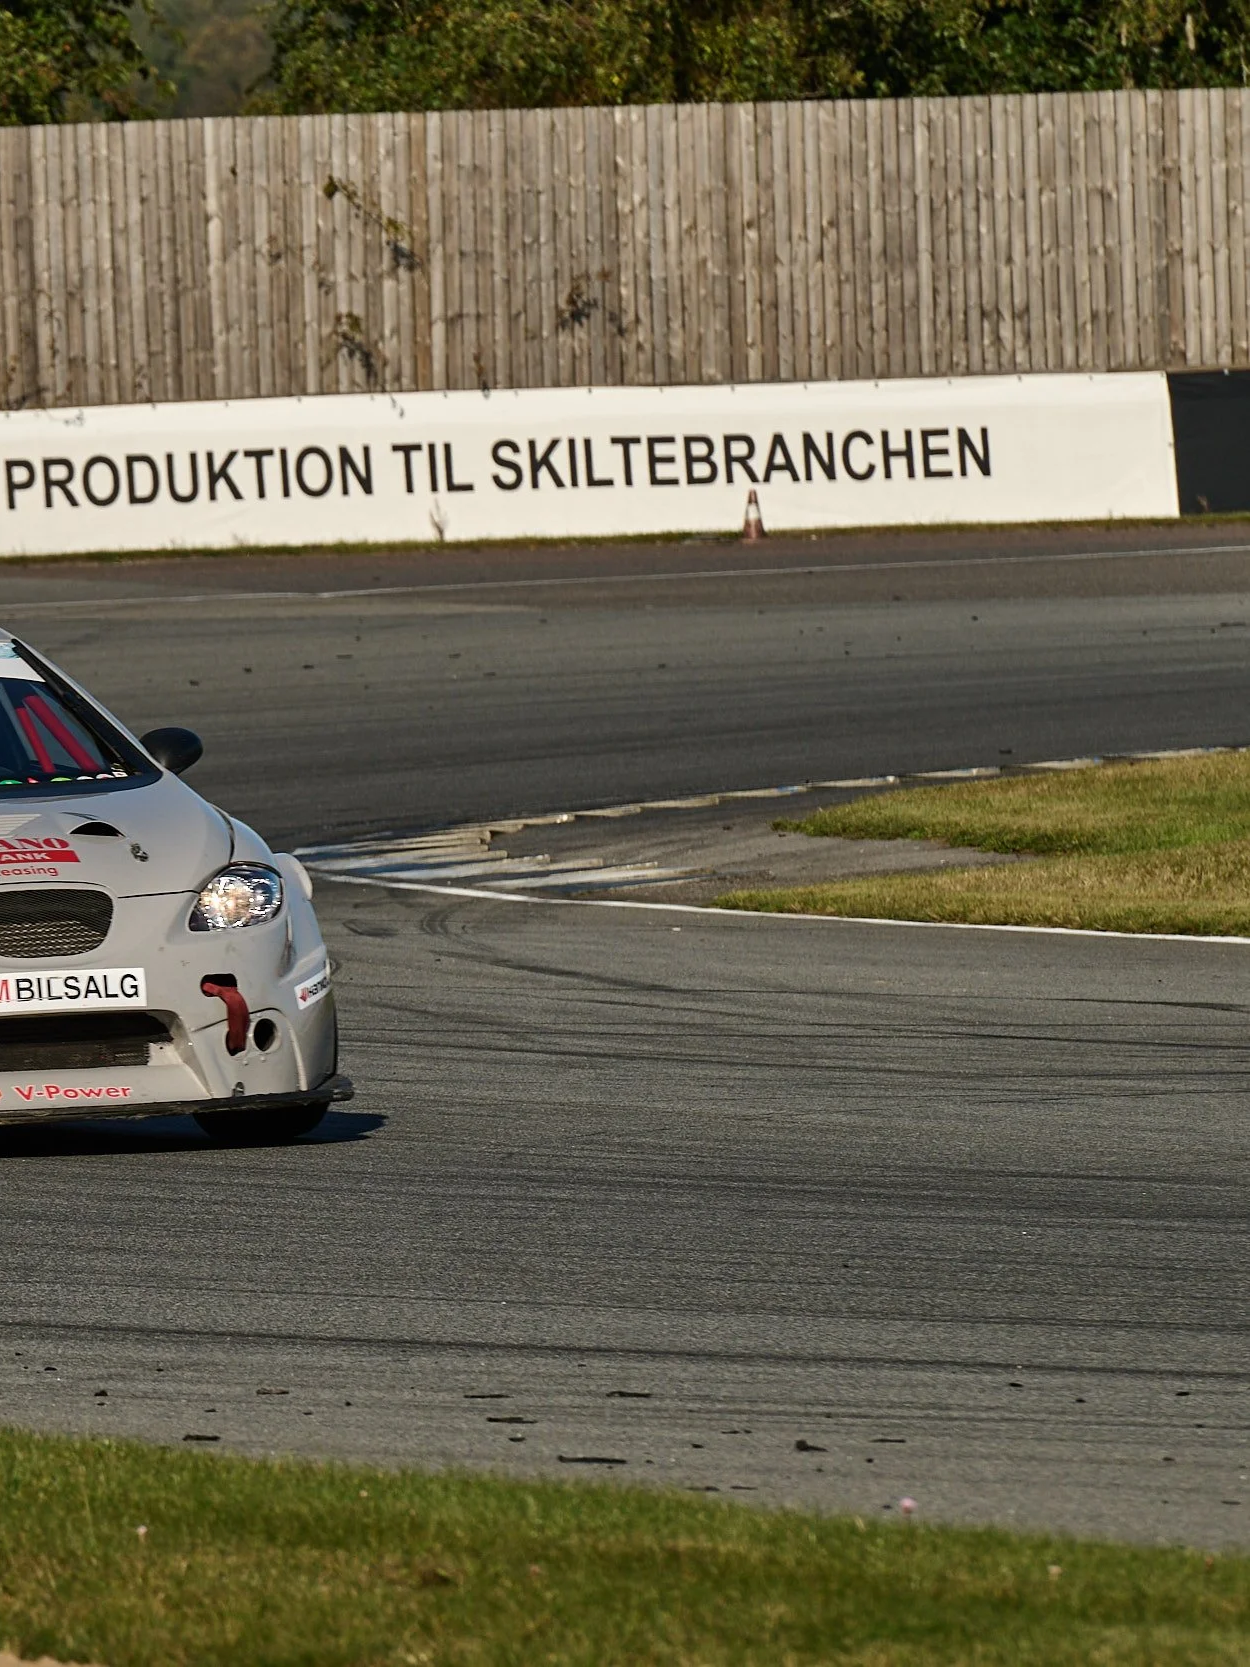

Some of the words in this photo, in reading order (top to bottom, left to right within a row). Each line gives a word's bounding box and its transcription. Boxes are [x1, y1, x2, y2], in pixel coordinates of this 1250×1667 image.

[5, 445, 374, 509] PRODUKTION
[392, 443, 474, 493] TIL
[491, 427, 992, 490] SKILTEBRANCHEN
[15, 1085, 133, 1101] V-Power
